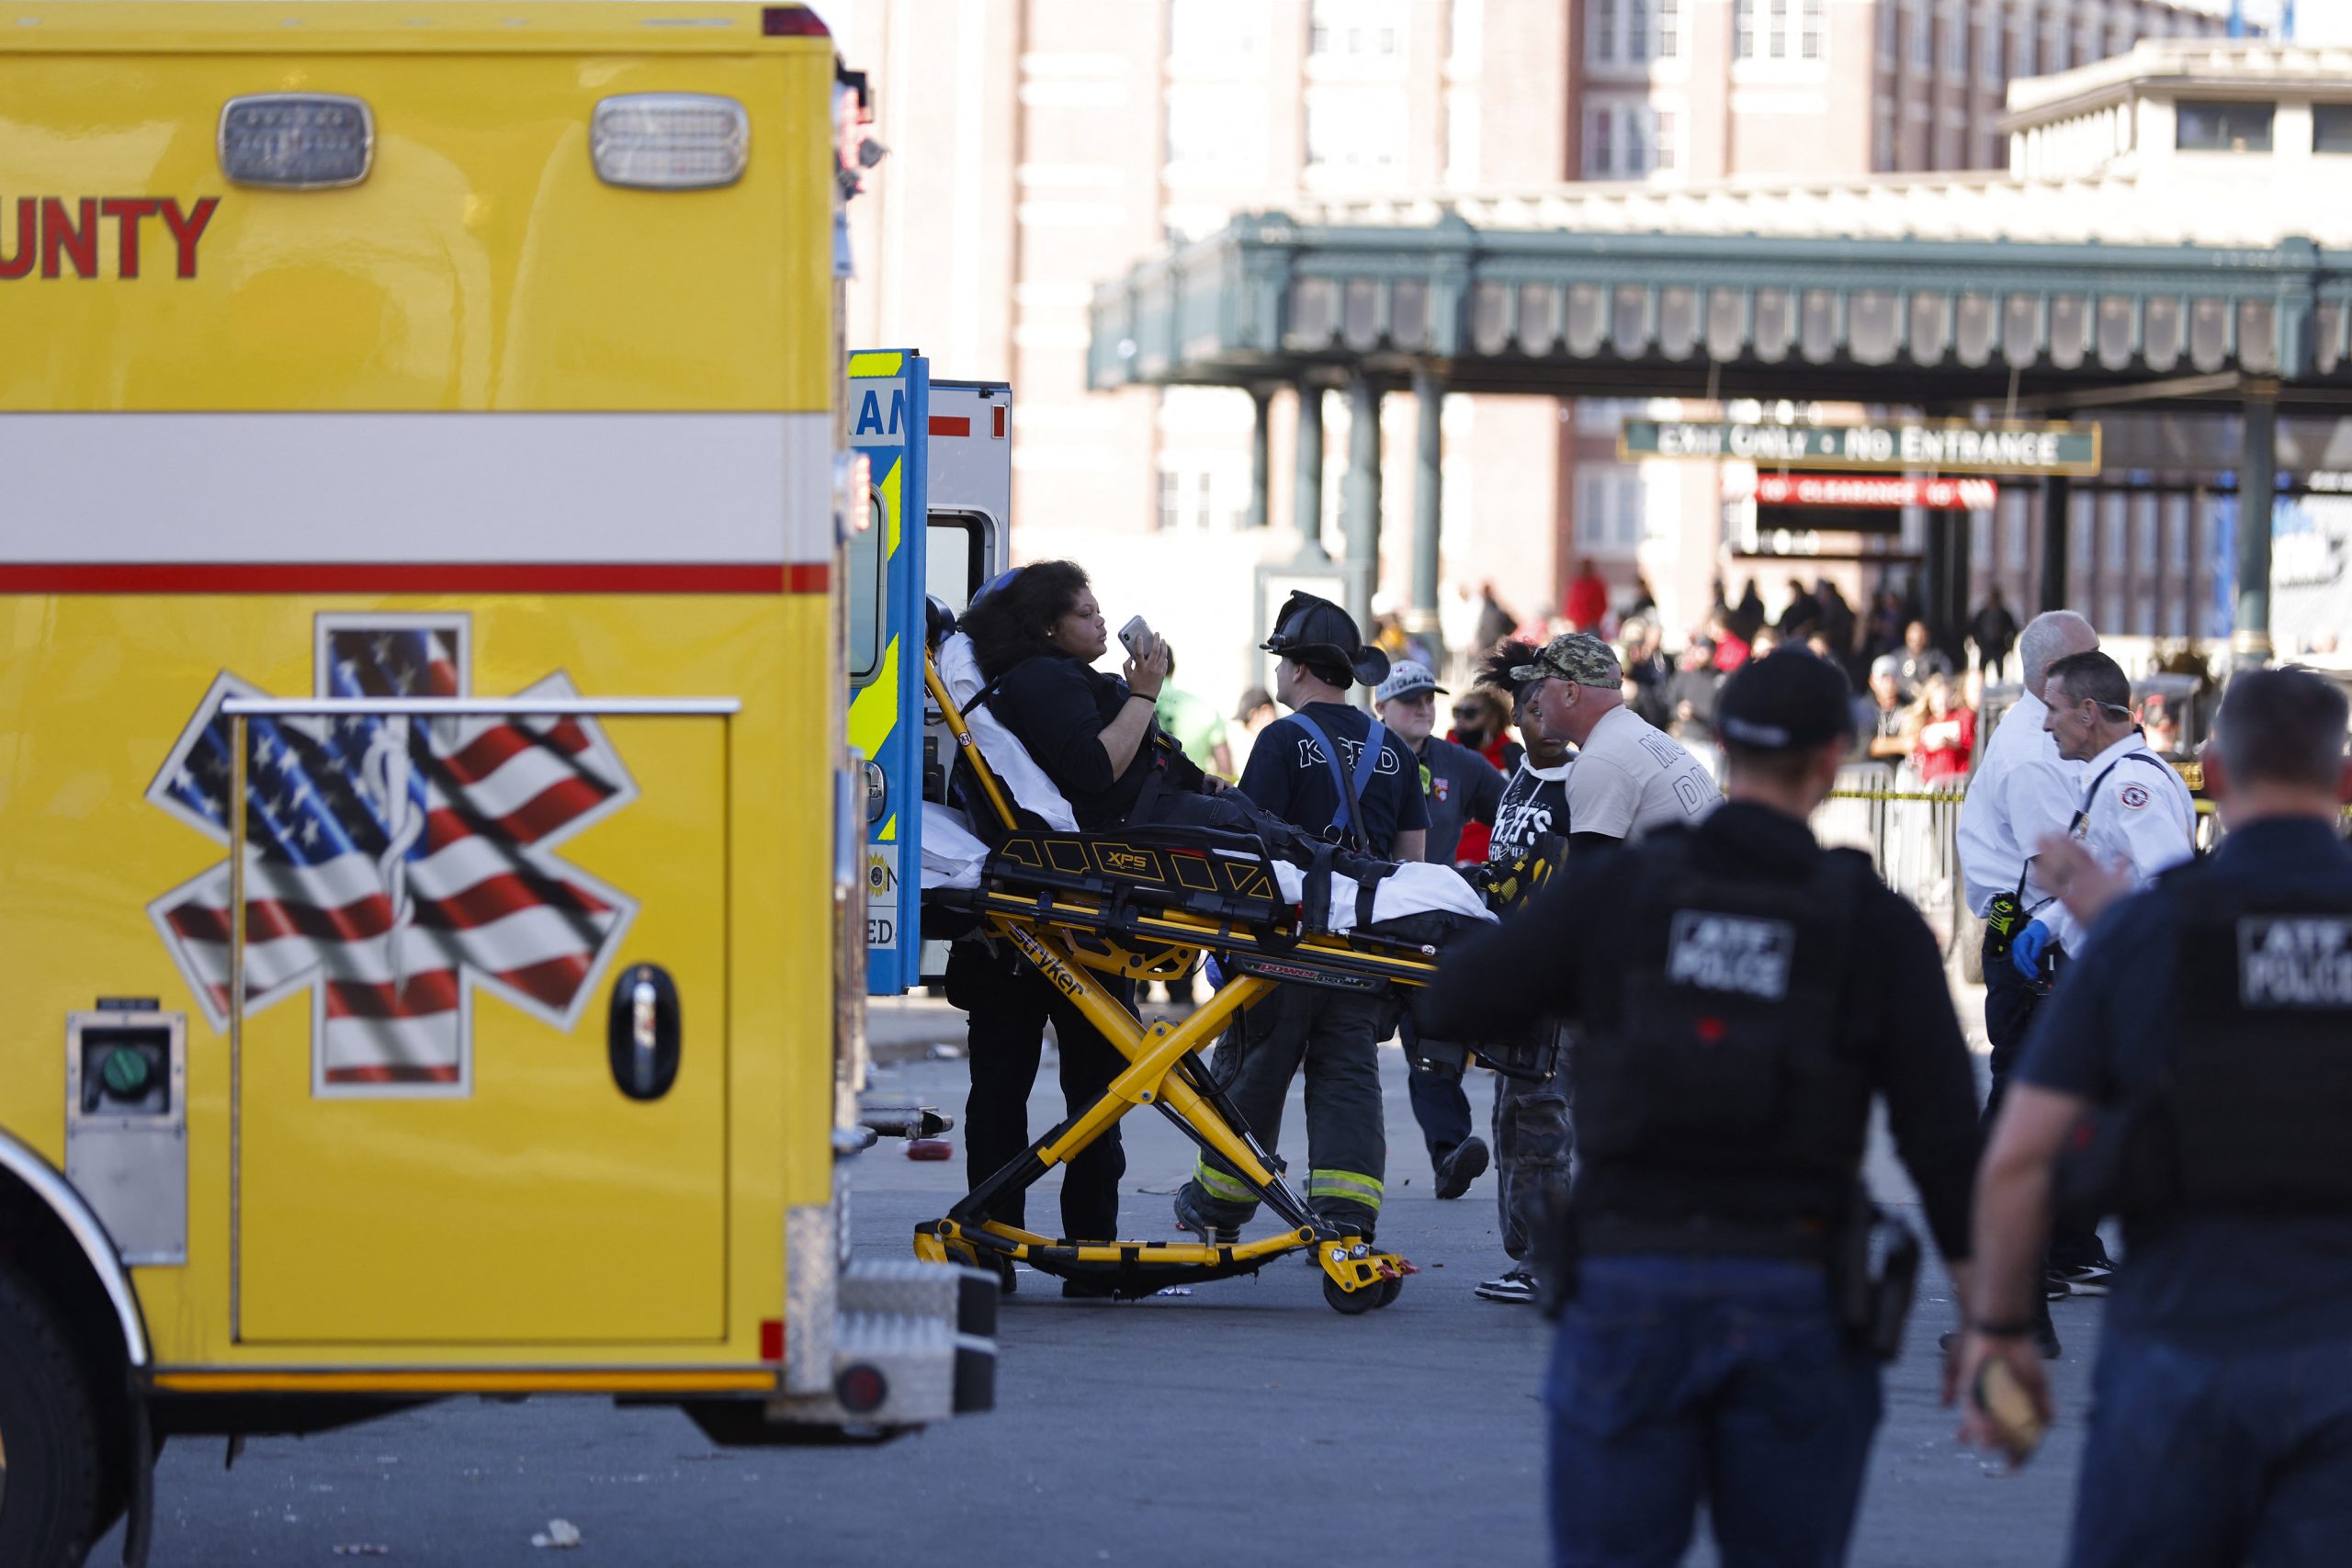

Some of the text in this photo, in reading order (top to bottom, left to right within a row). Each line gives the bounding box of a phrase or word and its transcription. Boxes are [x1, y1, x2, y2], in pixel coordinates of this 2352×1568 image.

[1658, 423, 2059, 466] EXIT ONLY NO ENTRANCE
[1106, 852, 1148, 868] XPS
[1693, 917, 1771, 957] ATF
[2261, 919, 2346, 958] ATF
[1669, 942, 1787, 999] POLICE
